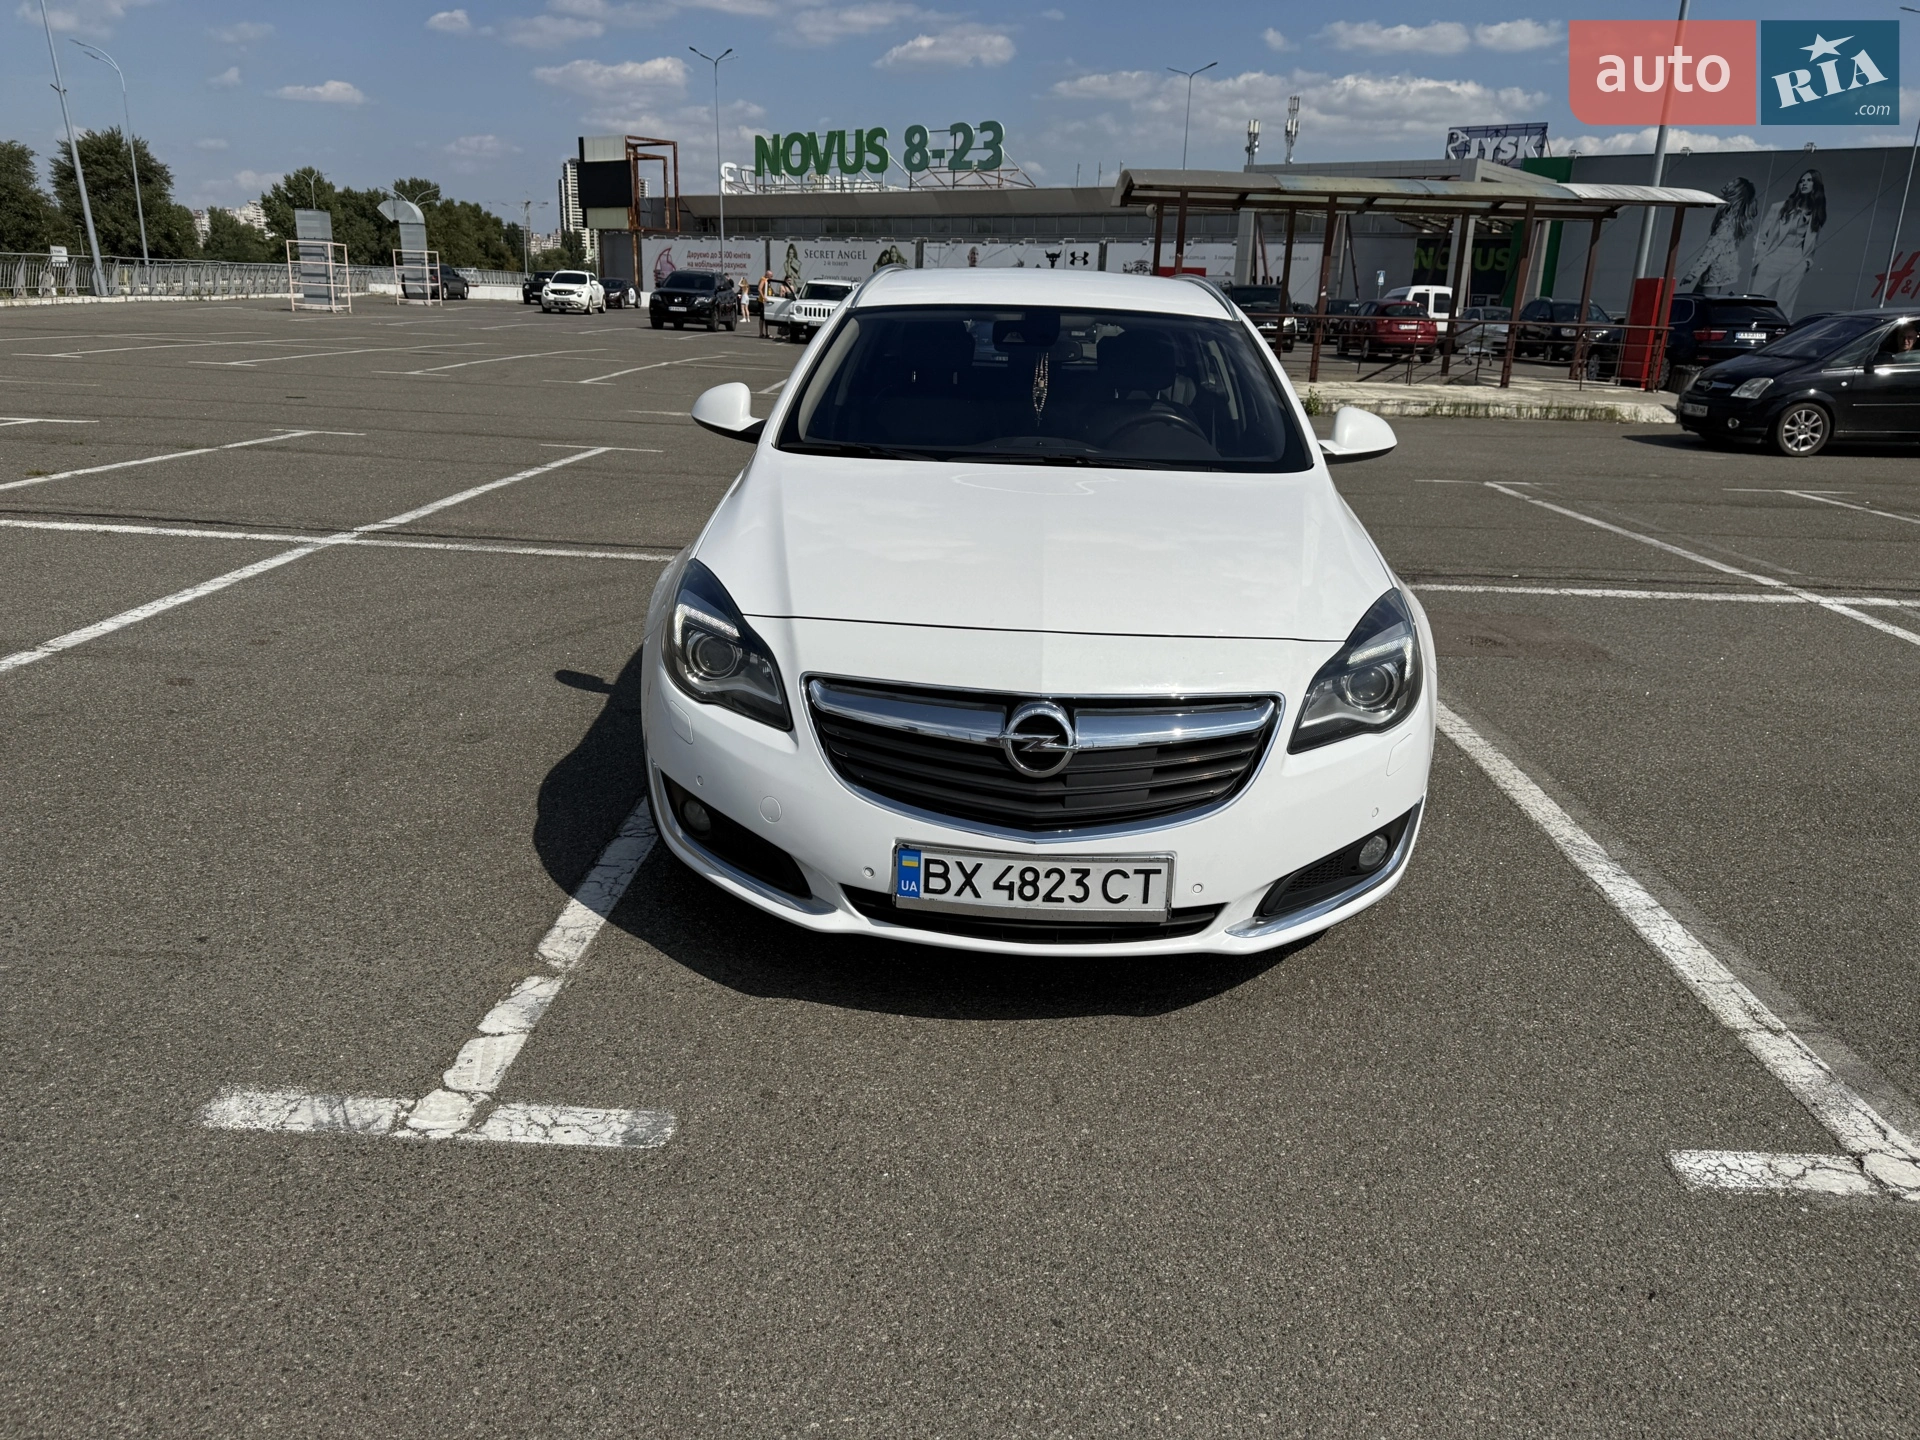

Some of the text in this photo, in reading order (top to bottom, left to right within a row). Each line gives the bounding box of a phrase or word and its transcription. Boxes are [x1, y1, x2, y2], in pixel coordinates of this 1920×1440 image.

[754, 120, 1005, 177] NOVUS 8-23
[1463, 135, 1540, 159] JYSK
[687, 250, 710, 259] Даруємо
[733, 251, 751, 259] юнітів
[695, 260, 723, 268] мобільний
[804, 249, 868, 260] SECRET ANGEL
[1413, 247, 1512, 271] NOUS
[901, 879, 918, 893] UA
[923, 859, 1162, 905] BX 4823 CT
